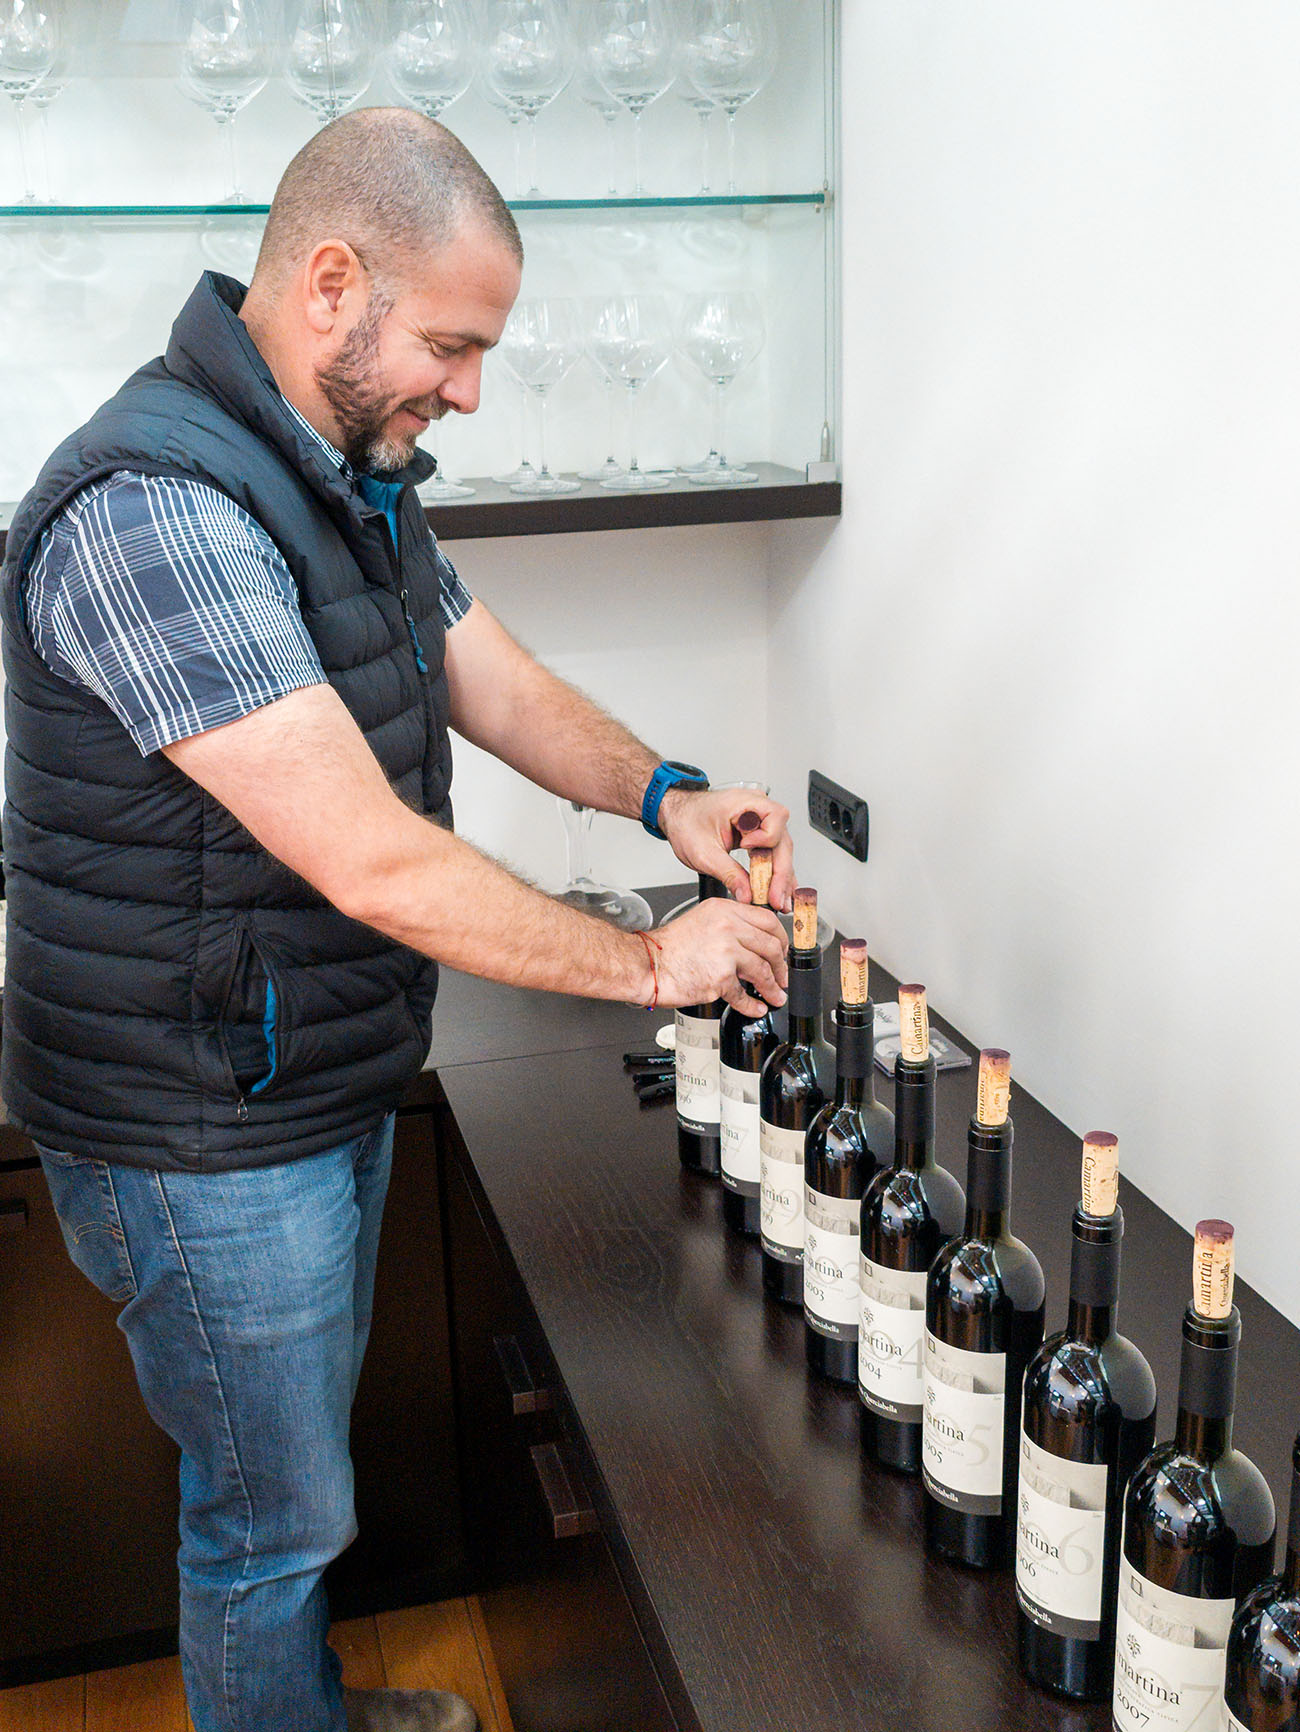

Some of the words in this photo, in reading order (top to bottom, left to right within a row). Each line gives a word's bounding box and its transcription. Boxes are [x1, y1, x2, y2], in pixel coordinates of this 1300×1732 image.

[1084, 1156, 1097, 1213] Camartina
[924, 1407, 965, 1442] artina
[923, 1434, 943, 1464] 005
[1018, 1519, 1060, 1560] artina
[1116, 1687, 1150, 1729] 2007
